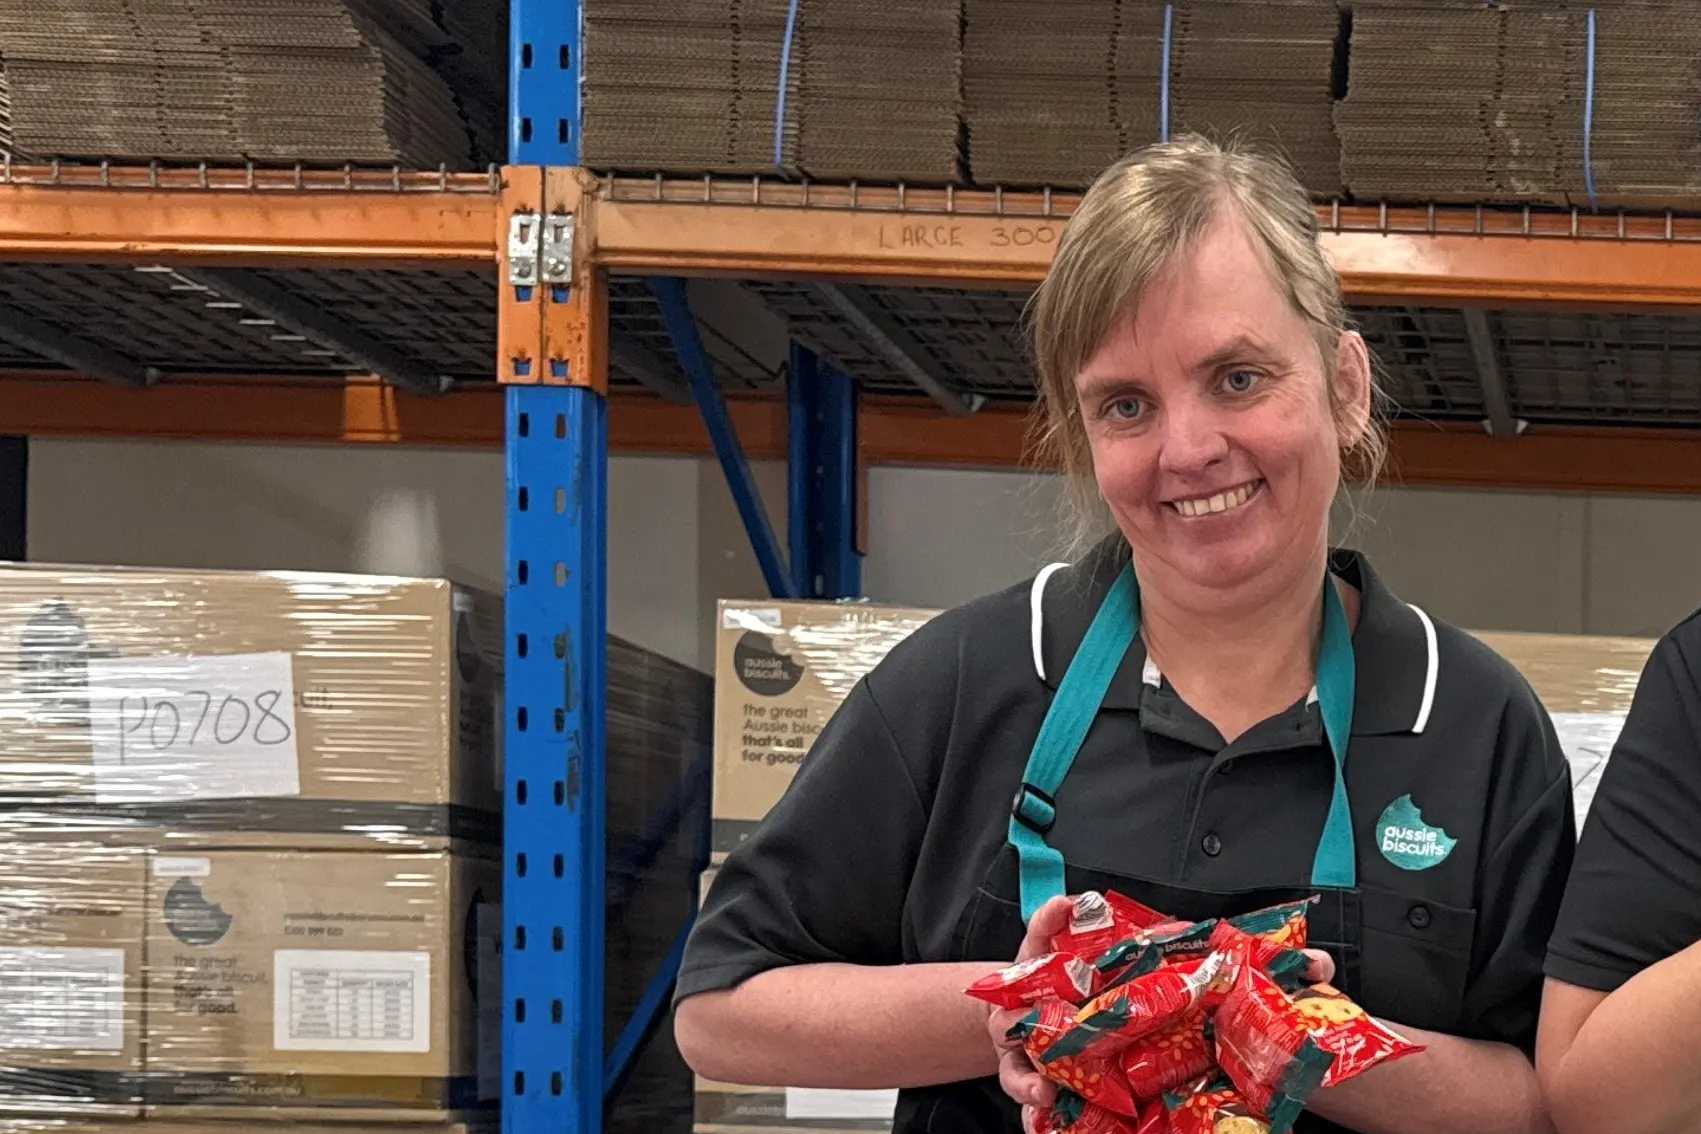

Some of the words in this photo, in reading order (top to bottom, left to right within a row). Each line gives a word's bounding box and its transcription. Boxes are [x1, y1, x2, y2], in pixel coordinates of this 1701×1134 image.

[879, 226, 963, 248] LARGE
[990, 227, 1055, 246] 300
[744, 658, 783, 668] aussie
[743, 705, 765, 718] the
[770, 705, 808, 719] great
[743, 720, 787, 733] Aussie
[742, 735, 782, 748] that's
[786, 736, 804, 749] all
[742, 749, 763, 762] for
[1384, 826, 1437, 843] aussie
